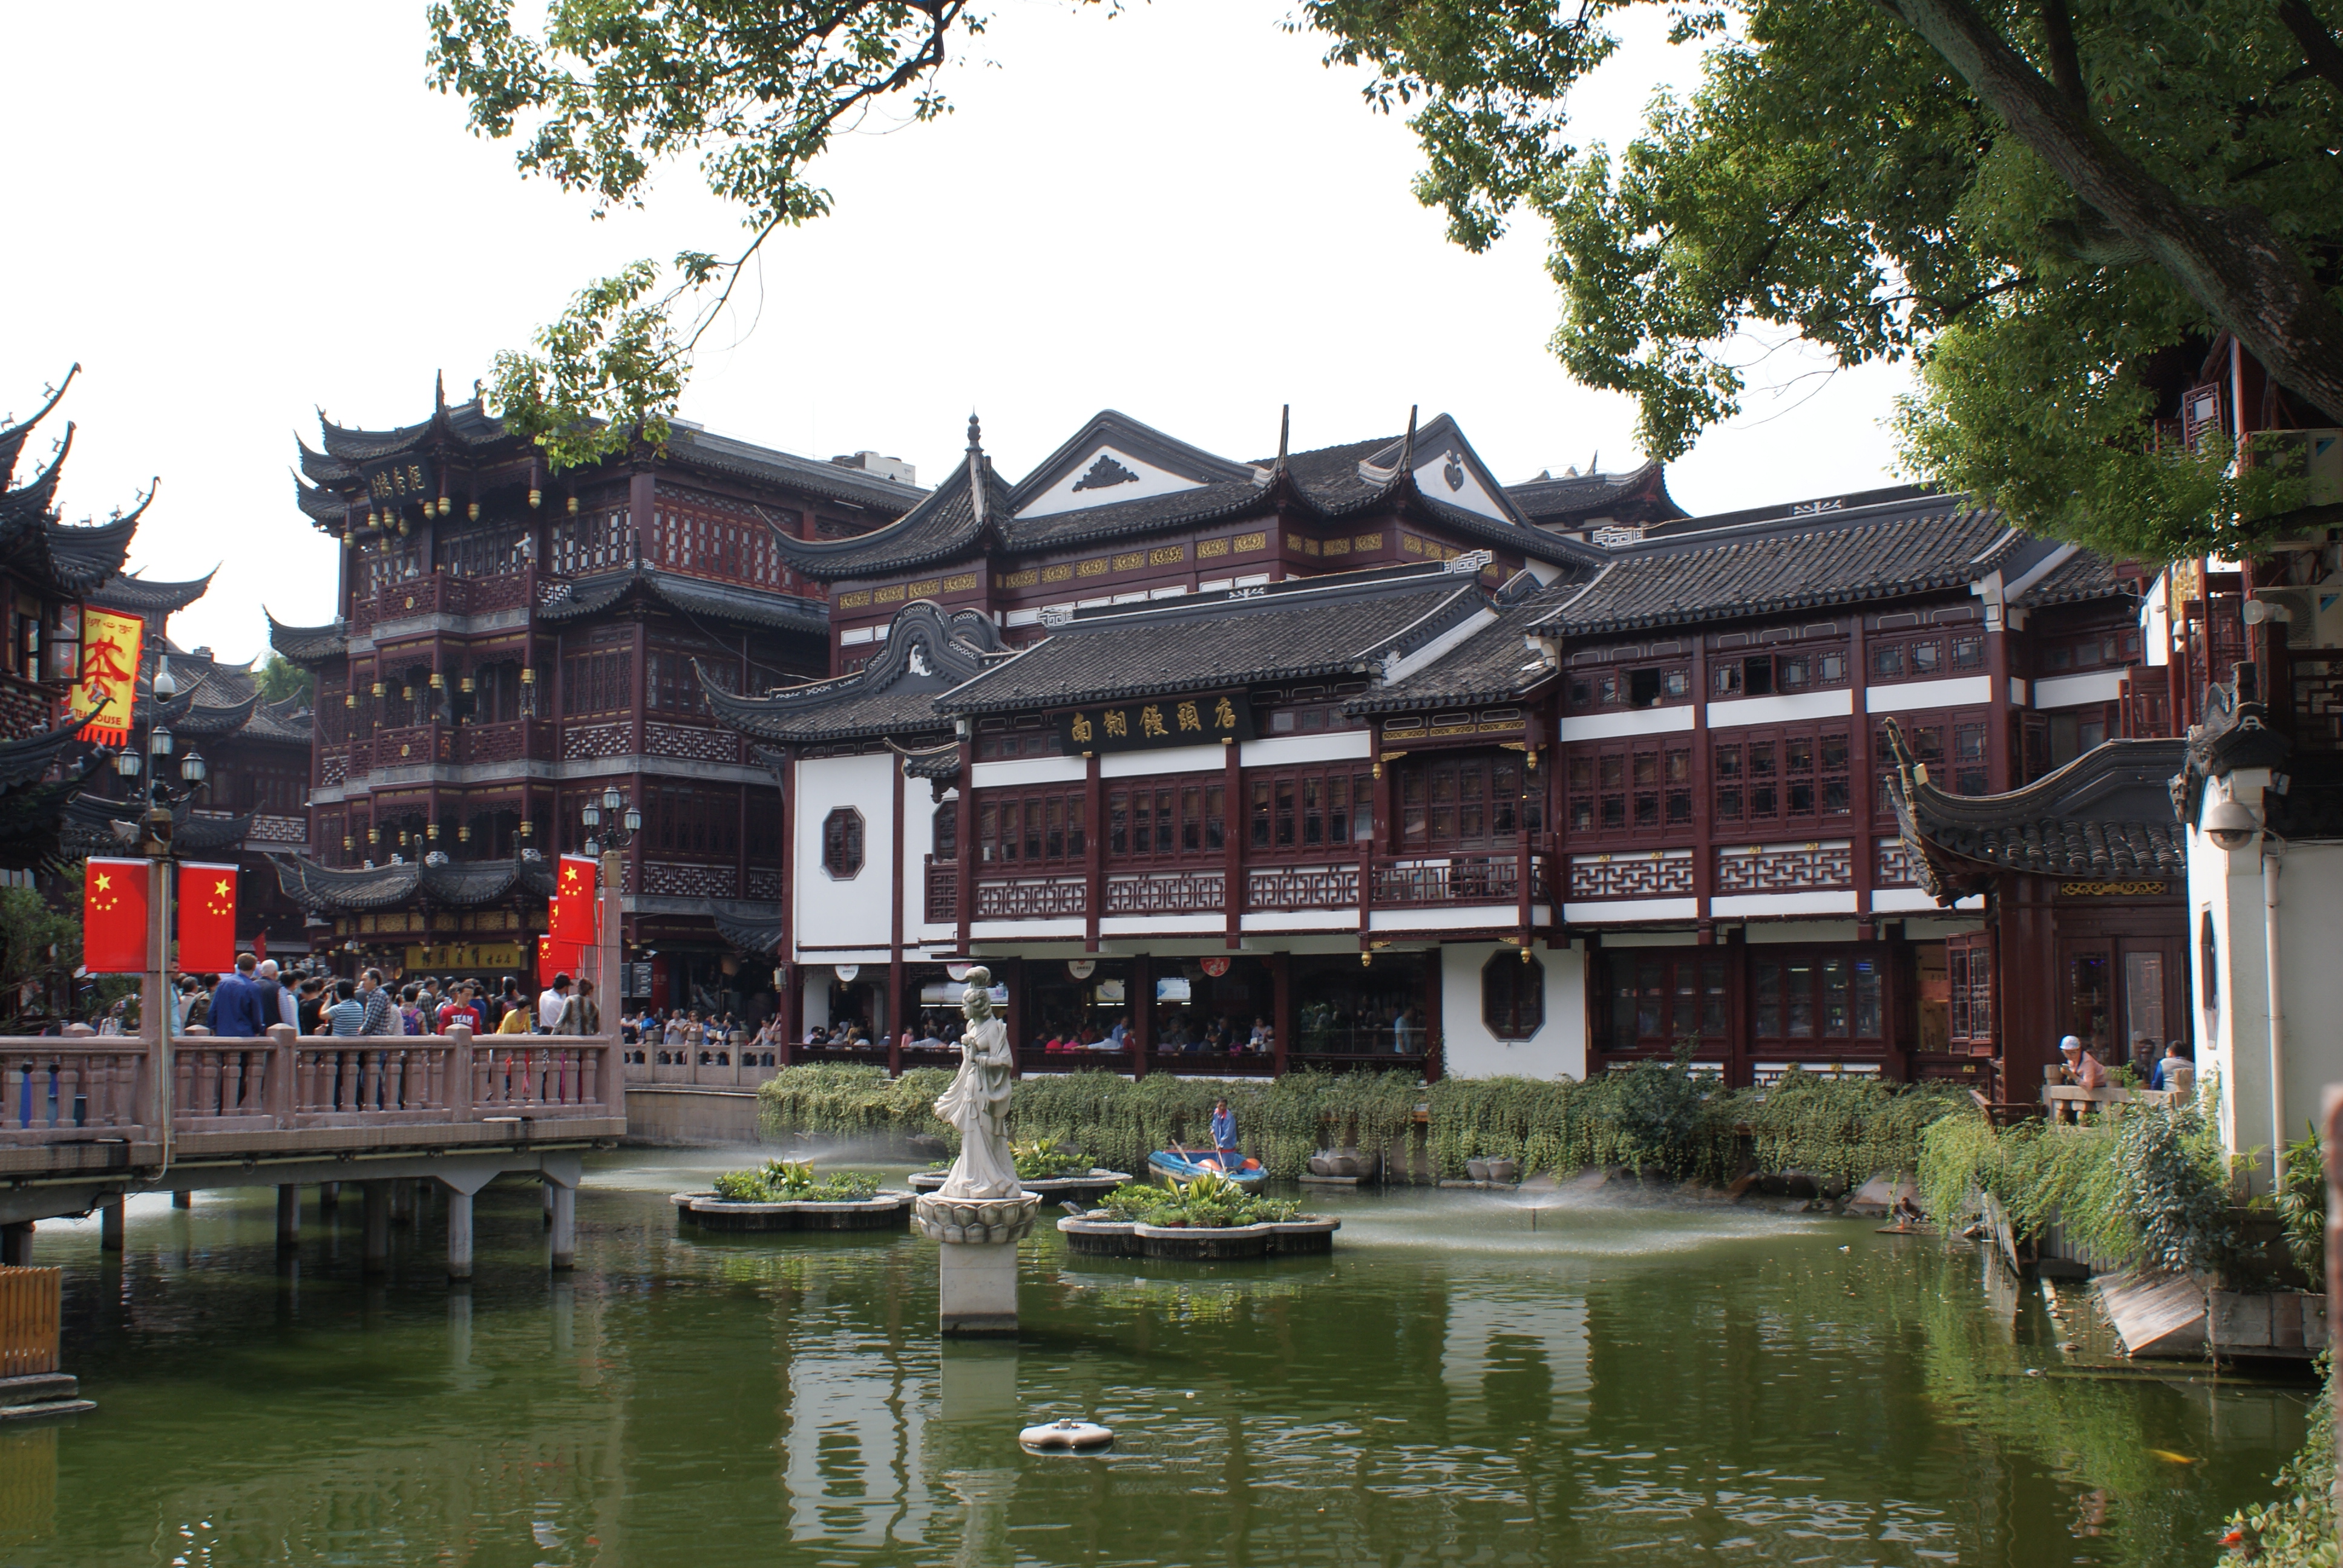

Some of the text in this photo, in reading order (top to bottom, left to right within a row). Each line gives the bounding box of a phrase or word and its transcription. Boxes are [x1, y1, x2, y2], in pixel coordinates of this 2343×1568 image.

[81, 635, 130, 704] 茶
[94, 714, 122, 725] OUSE
[451, 1014, 474, 1025] TEAM
